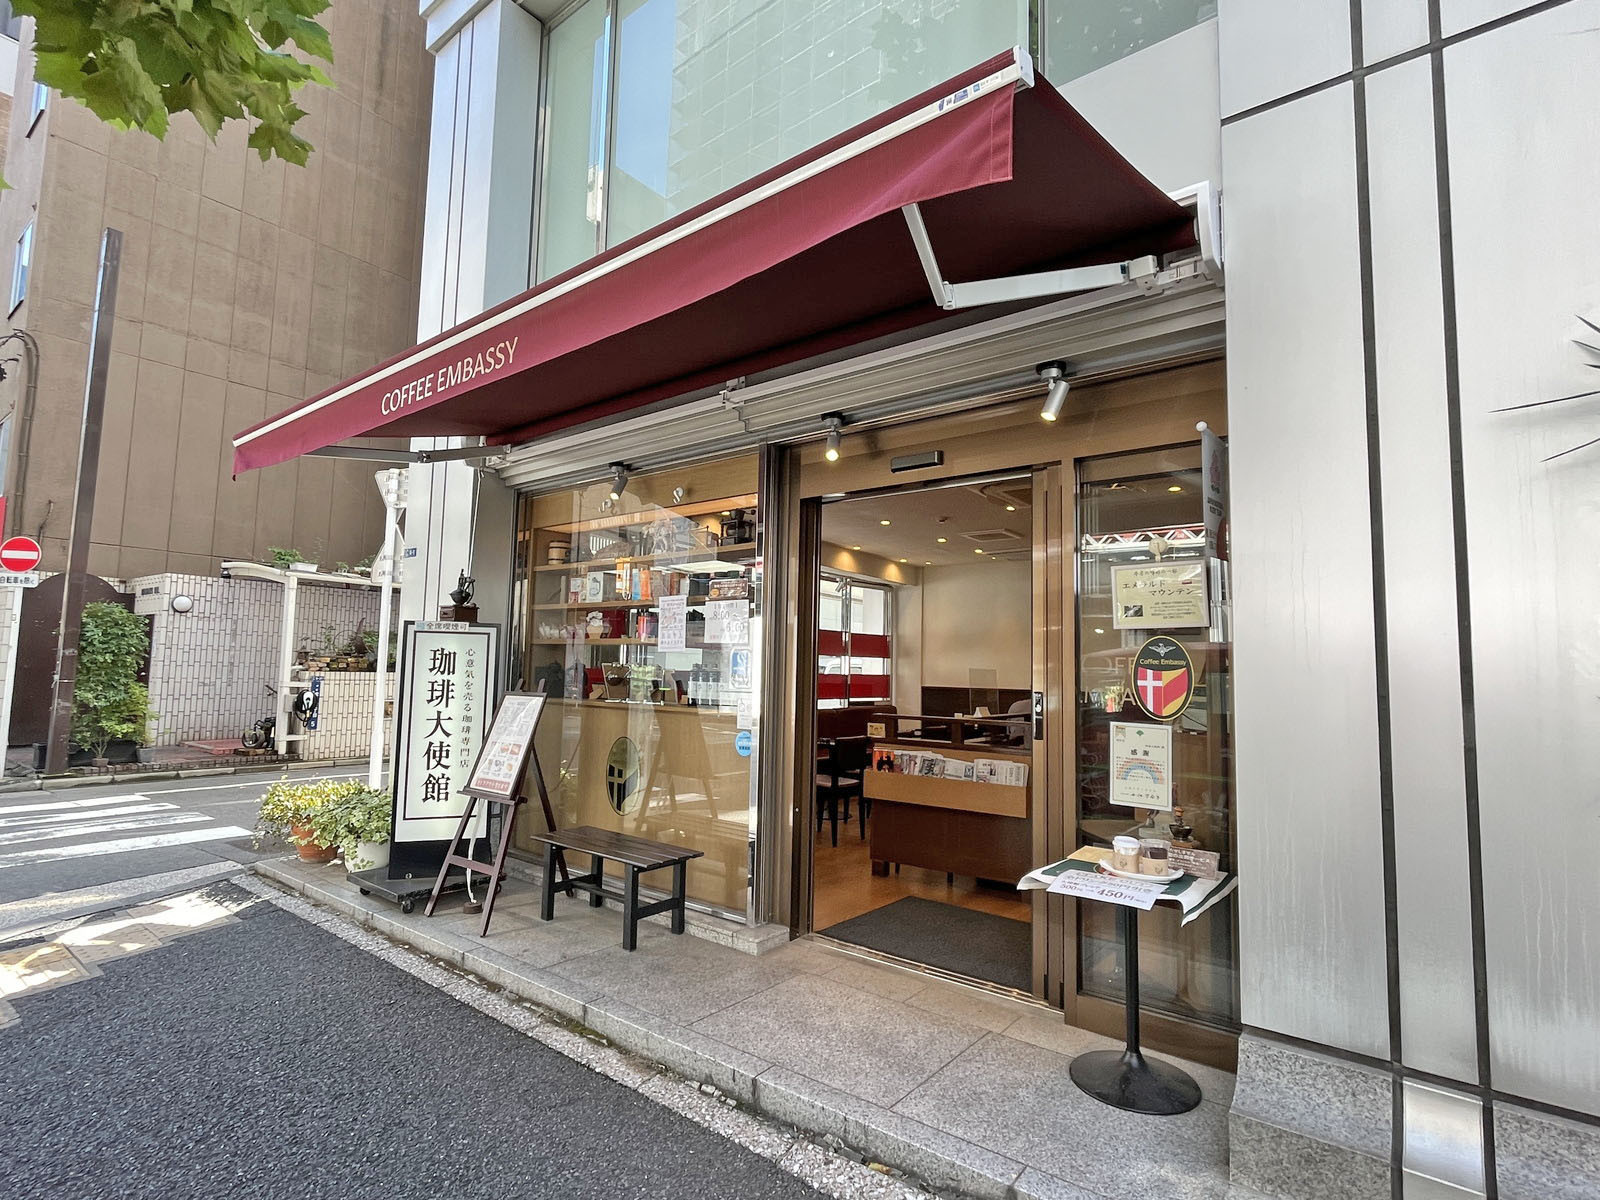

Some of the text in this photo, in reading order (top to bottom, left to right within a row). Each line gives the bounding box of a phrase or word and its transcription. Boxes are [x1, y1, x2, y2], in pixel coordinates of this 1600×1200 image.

[381, 337, 518, 415] COFFEE EMBASSY
[422, 648, 457, 803] 珈琲大使館
[459, 648, 476, 768] 心意気を売る珈琲専門店
